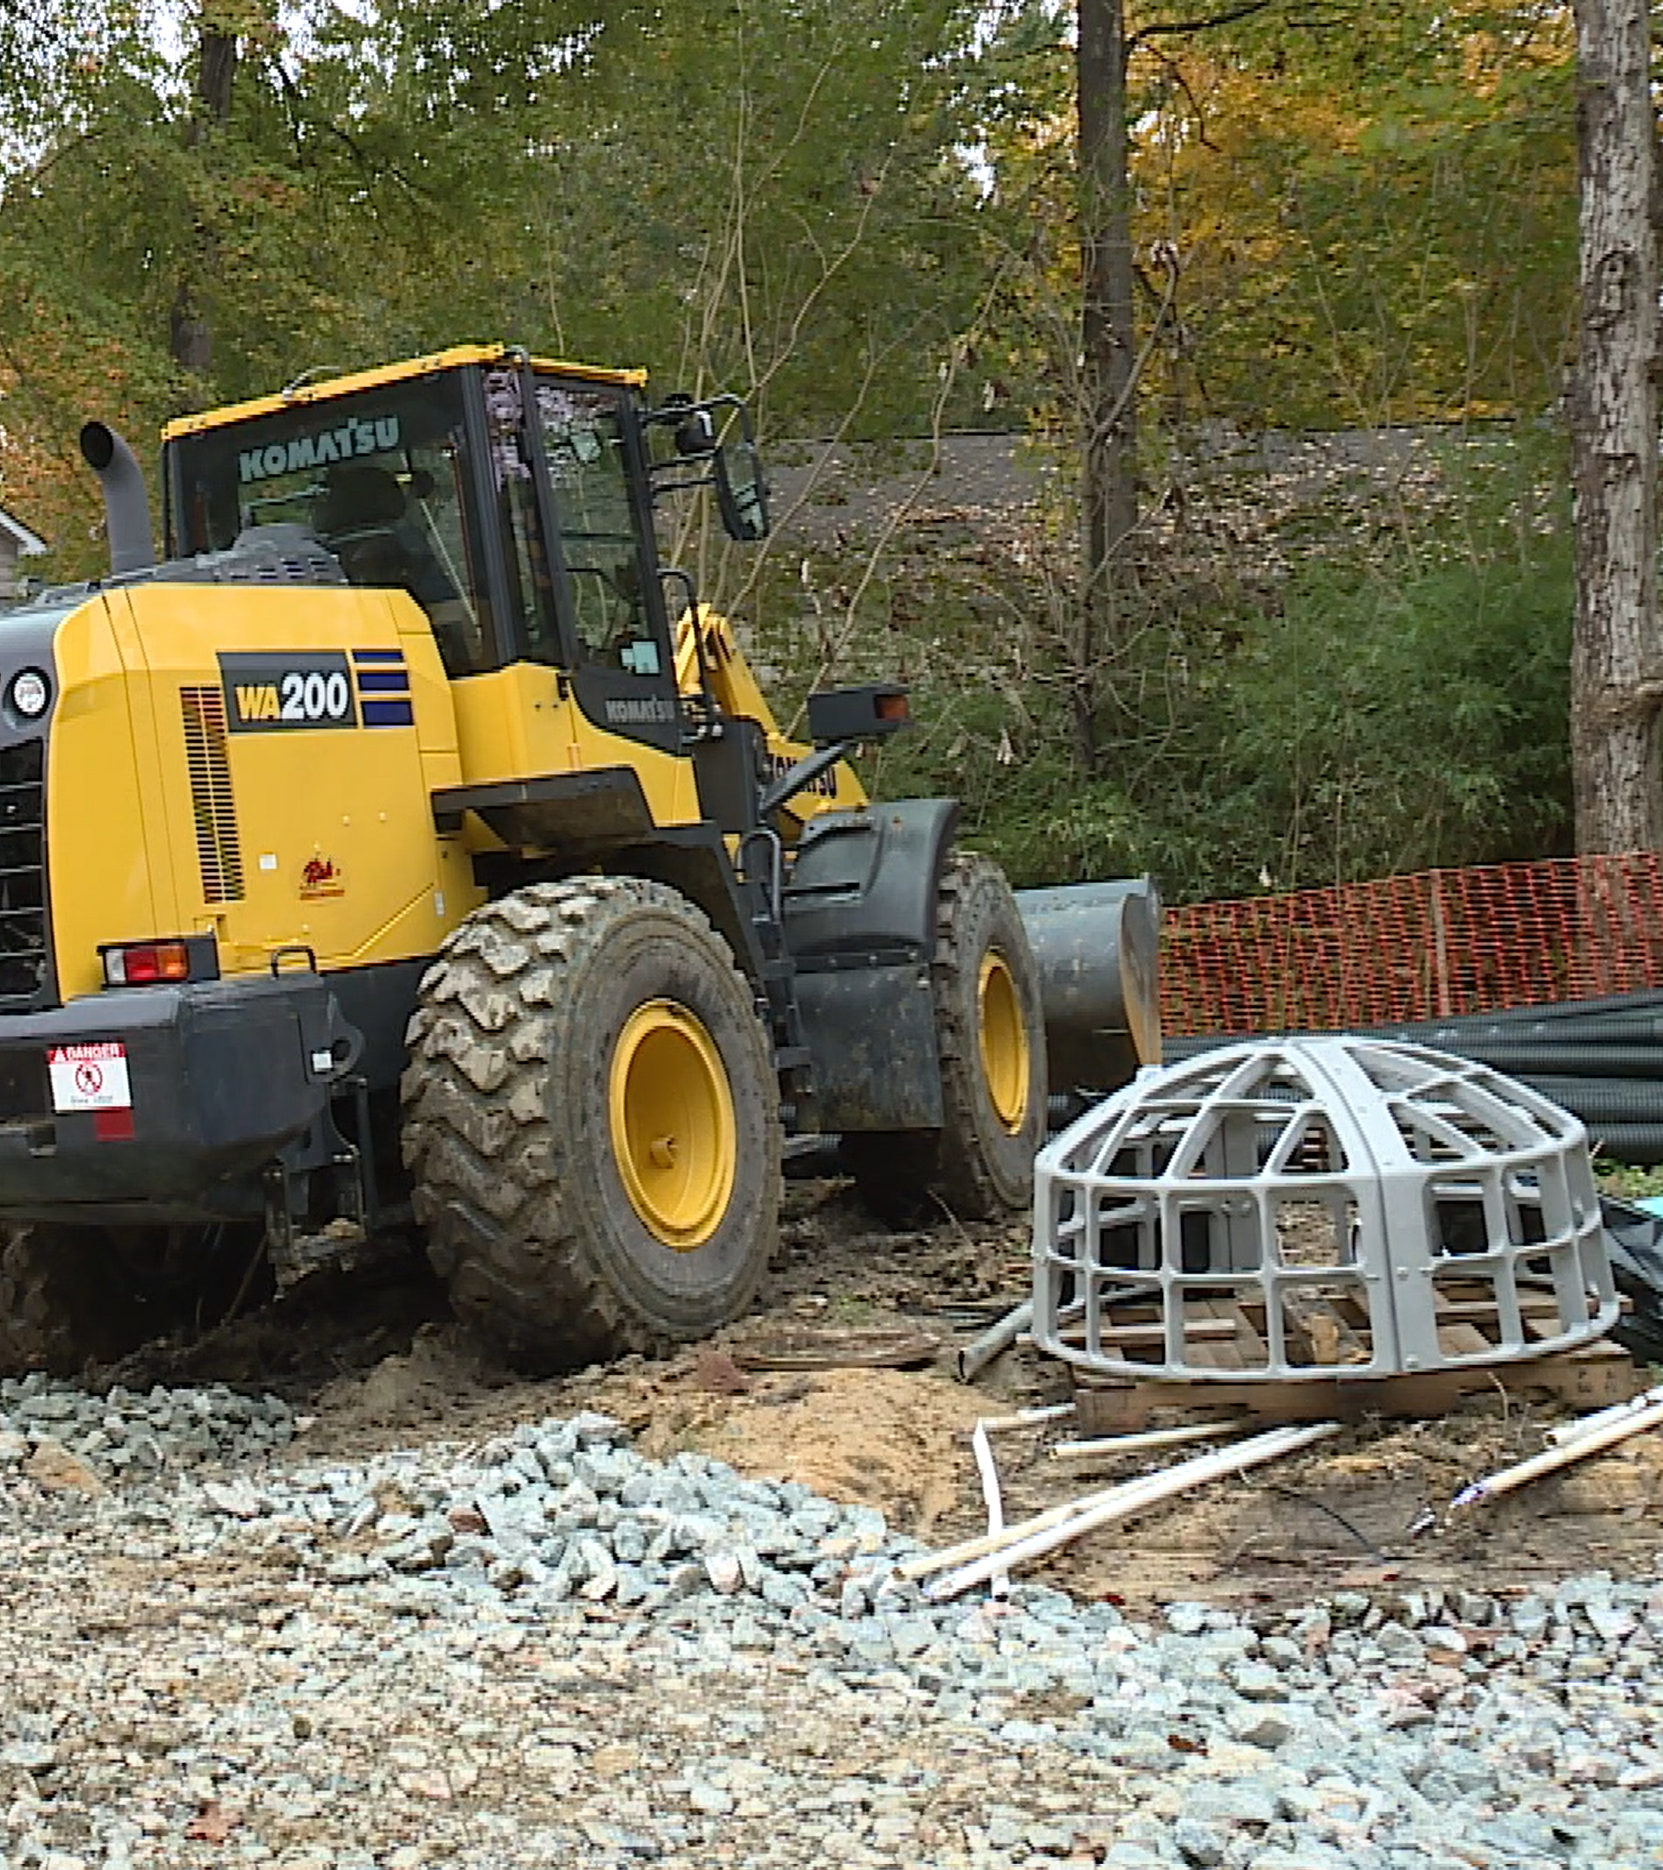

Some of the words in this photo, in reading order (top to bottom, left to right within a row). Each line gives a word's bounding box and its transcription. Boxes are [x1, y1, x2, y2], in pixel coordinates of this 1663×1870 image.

[239, 416, 400, 483] KOMATSU
[235, 672, 348, 720] WA200
[605, 693, 675, 722] KOMATSU
[66, 1043, 119, 1061] DANGER
